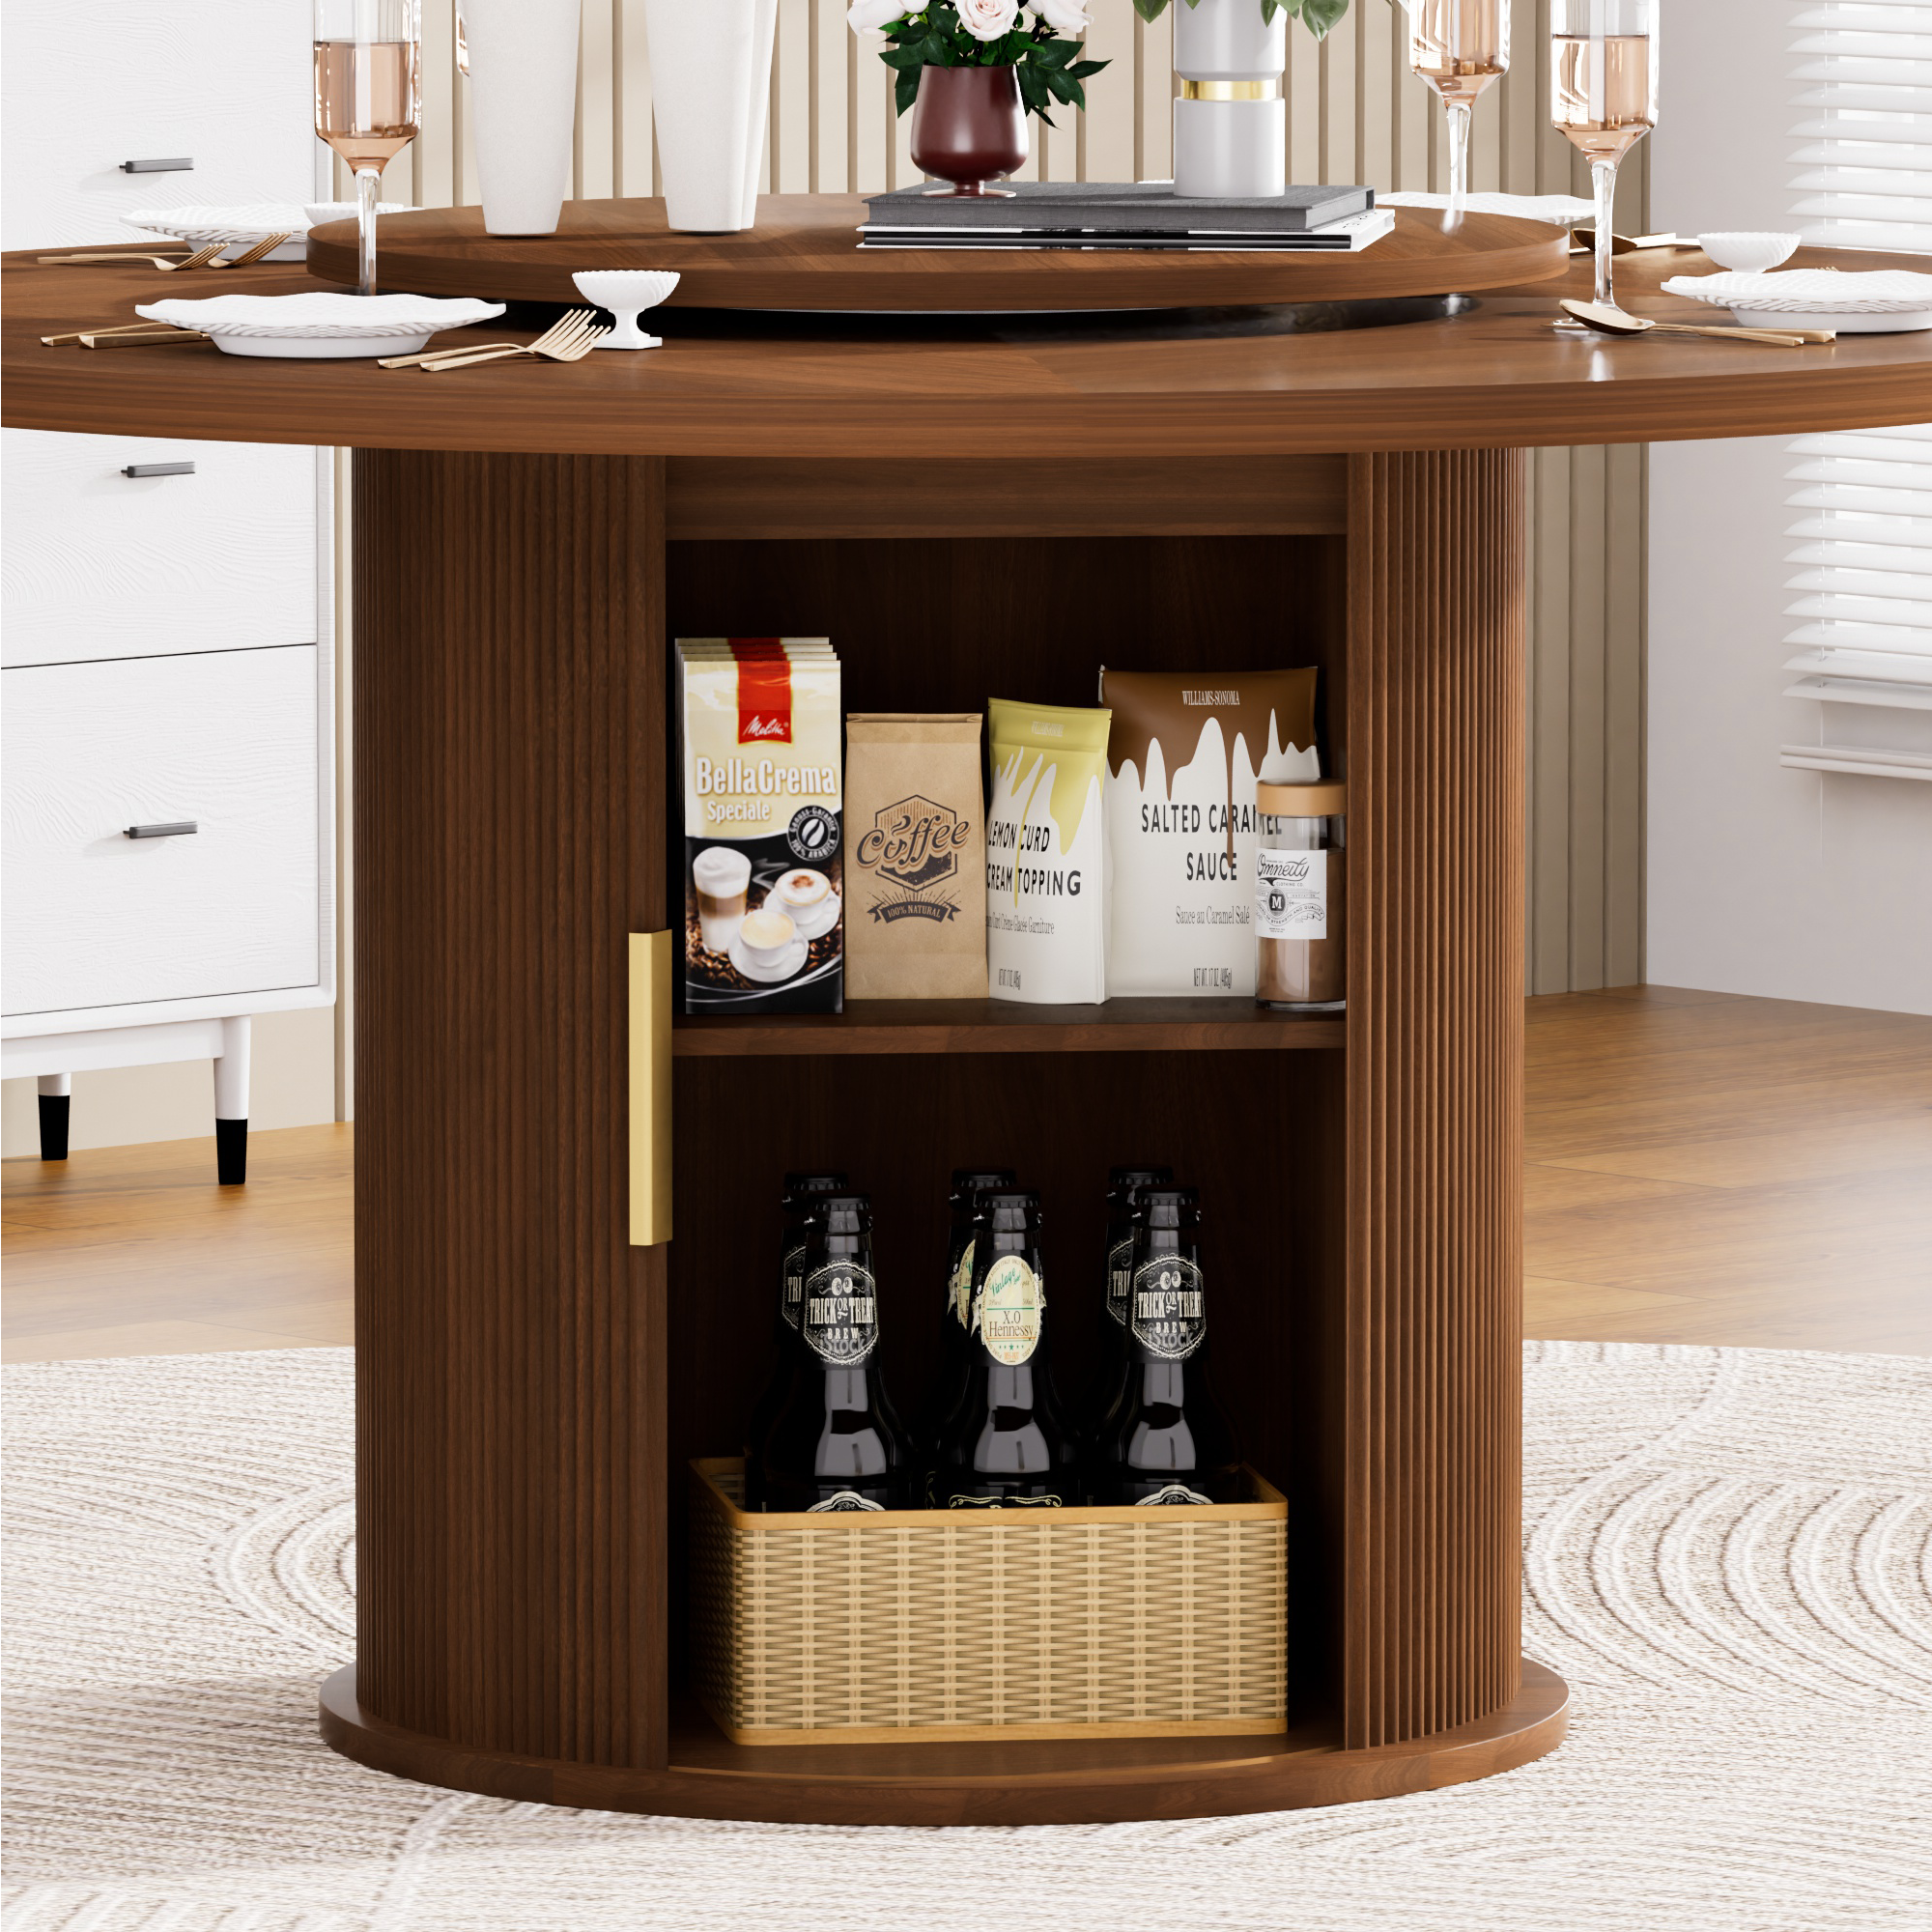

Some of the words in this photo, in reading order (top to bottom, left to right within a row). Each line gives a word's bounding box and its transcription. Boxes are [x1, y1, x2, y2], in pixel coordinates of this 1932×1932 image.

[1181, 690, 1240, 706] WILLIAMS-SONOMA
[743, 715, 785, 737] Melitta
[696, 756, 837, 795] BellaCrema
[707, 800, 771, 825] Speciale
[1142, 804, 1201, 833] SALTED
[857, 815, 970, 867] Coffee
[988, 820, 1017, 849] LEMON
[1020, 824, 1050, 852] CURD
[808, 838, 837, 859] ARABICA
[1186, 852, 1237, 881] SAUCE
[986, 863, 1013, 893] CREAM
[1017, 867, 1081, 896] TOPPING
[887, 906, 907, 919] 100%
[908, 905, 941, 919] NATURAL
[1271, 895, 1283, 909] M
[1028, 916, 1055, 935] Garniture
[1176, 905, 1196, 924] Sauce
[1197, 911, 1206, 924] au
[1206, 905, 1235, 924] Caramel
[1236, 905, 1250, 924] Salé
[788, 1277, 803, 1303] TRI
[1112, 1270, 1131, 1296] TRI
[810, 1298, 838, 1324] TRICK
[837, 1297, 849, 1311] OR
[848, 1297, 874, 1323] TREAT
[1003, 1310, 1021, 1324] X.O
[1138, 1293, 1166, 1319] TRICK
[1165, 1292, 1178, 1305] OR
[1178, 1292, 1202, 1318] TREAT
[827, 1328, 859, 1340] BREW
[989, 1321, 1034, 1338] Hennessy
[1156, 1321, 1187, 1333] BREW
